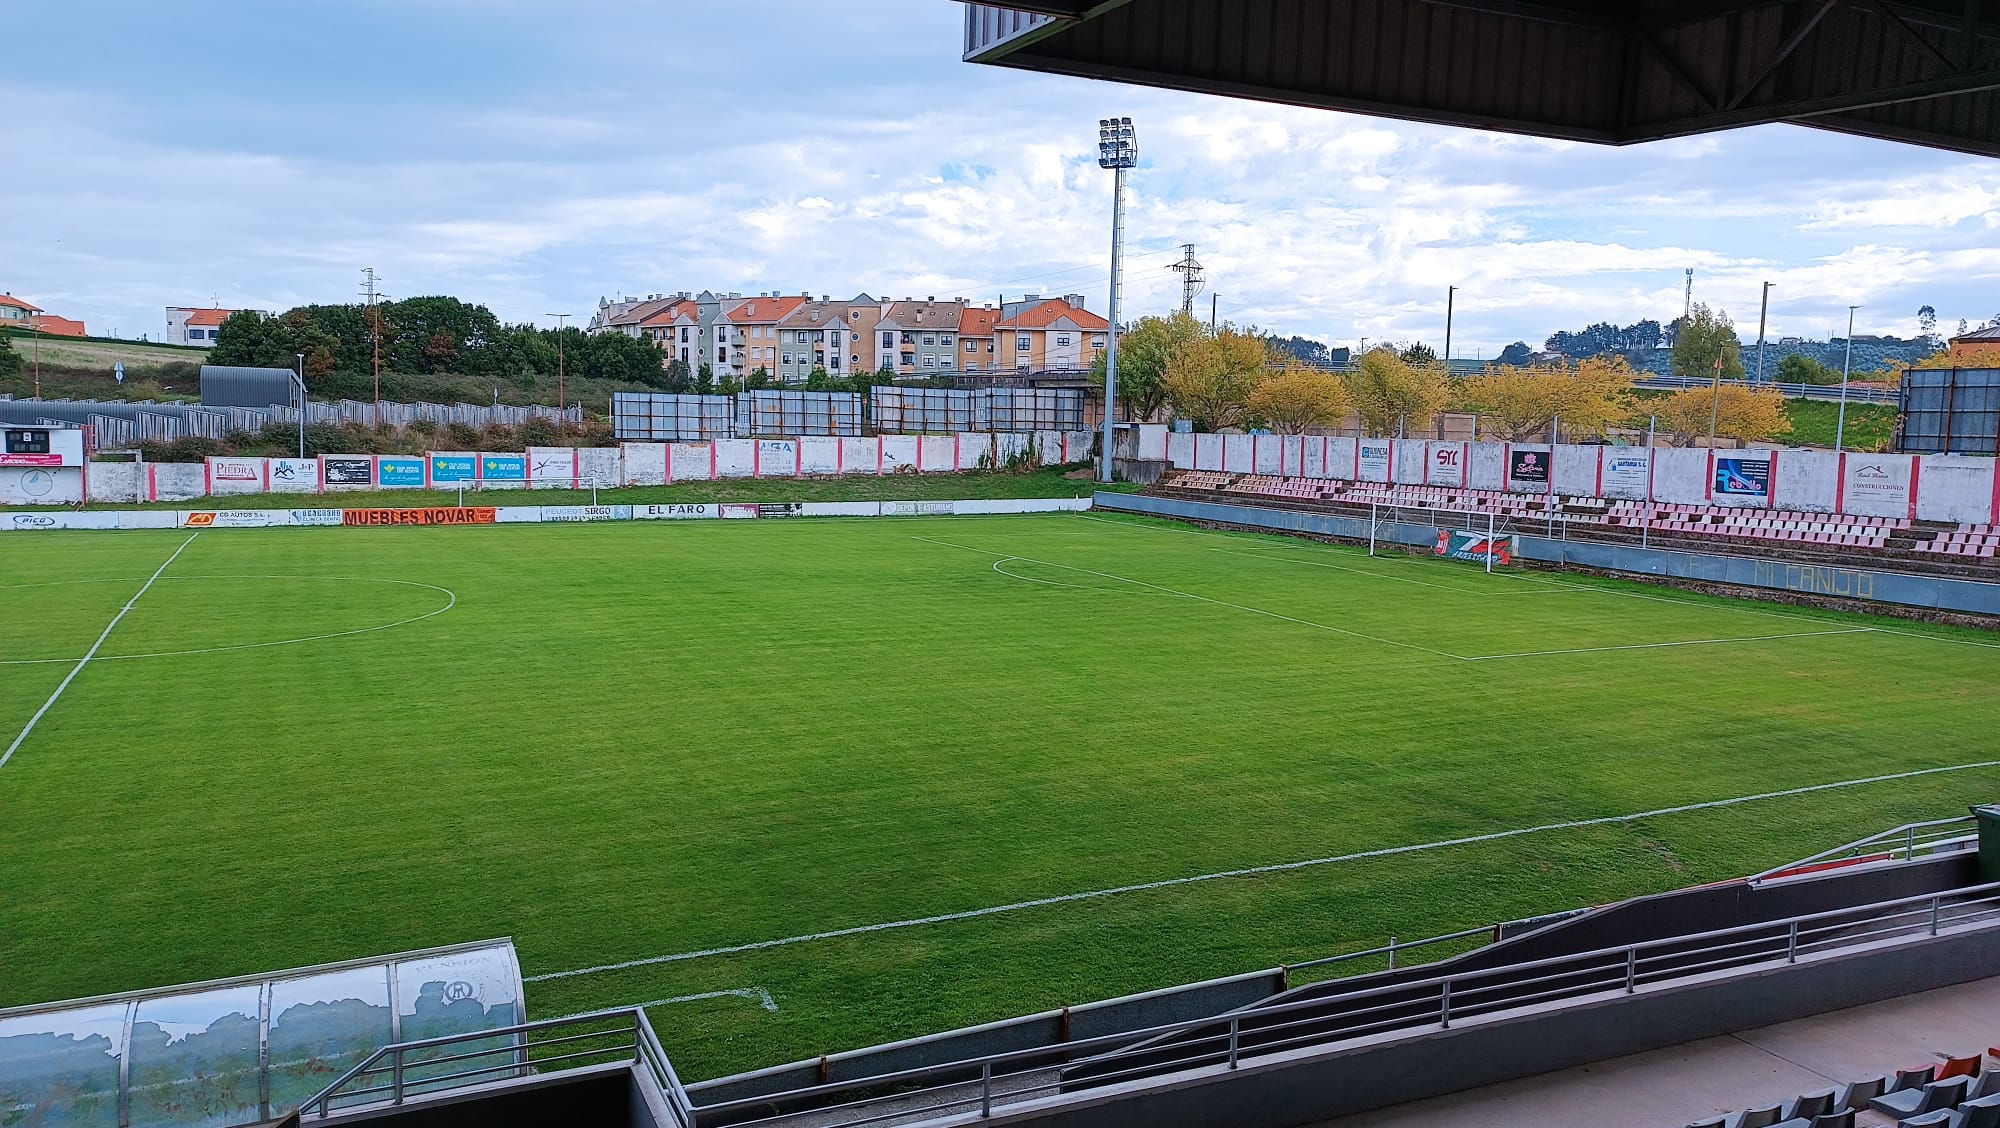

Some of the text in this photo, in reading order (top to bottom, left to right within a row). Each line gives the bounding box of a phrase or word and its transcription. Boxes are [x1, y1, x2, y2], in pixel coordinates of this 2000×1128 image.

[216, 463, 256, 477] PIEDRA
[649, 505, 705, 514] EL FARO
[345, 510, 419, 525] MUEBLES
[424, 509, 475, 524] NOVAR
